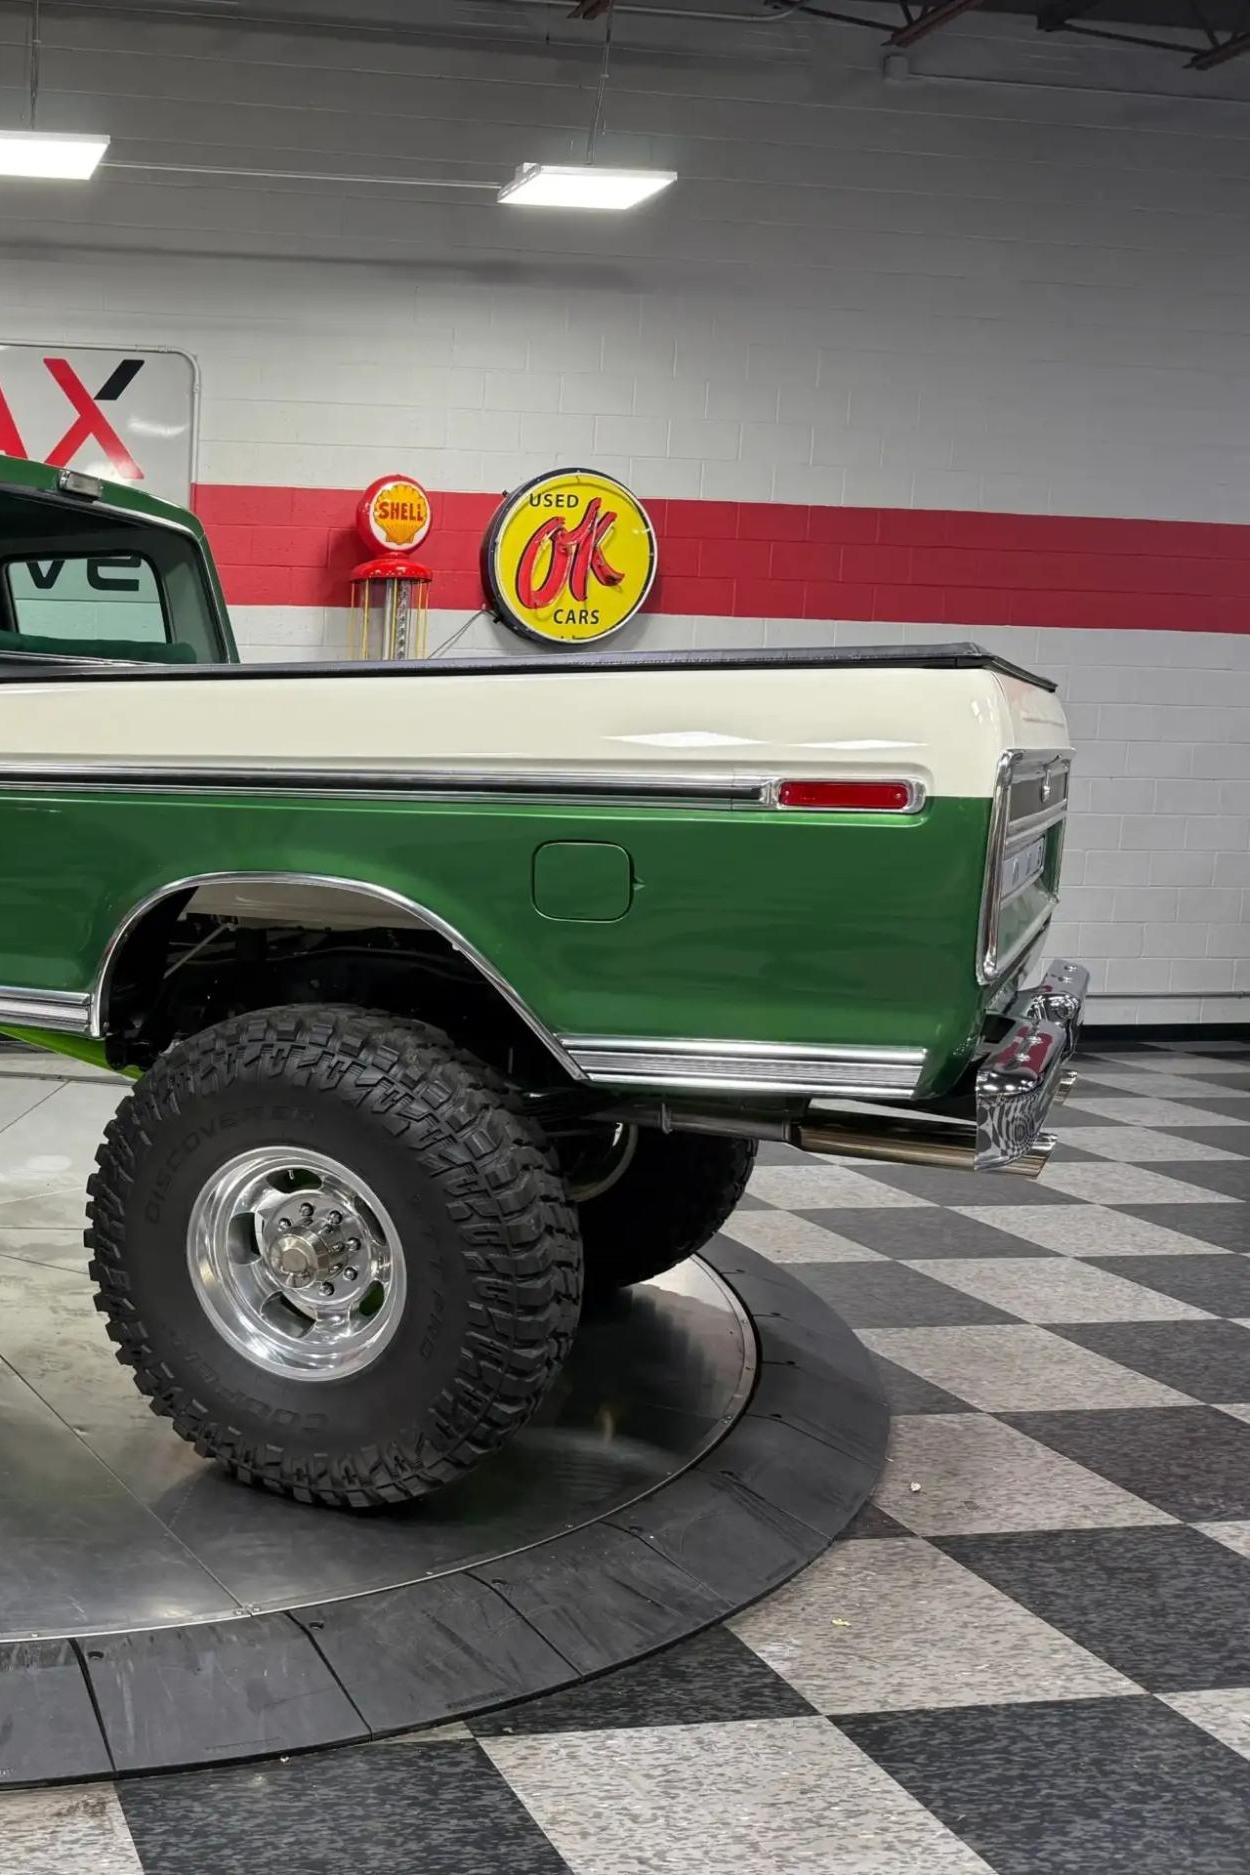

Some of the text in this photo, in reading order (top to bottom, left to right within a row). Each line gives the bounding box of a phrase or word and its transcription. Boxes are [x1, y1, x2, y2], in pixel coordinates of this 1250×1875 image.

[528, 493, 579, 508] USED
[378, 501, 424, 522] SHELL
[515, 497, 625, 609] OK
[553, 609, 600, 625] CARS
[144, 1105, 317, 1225] DISCOVERER
